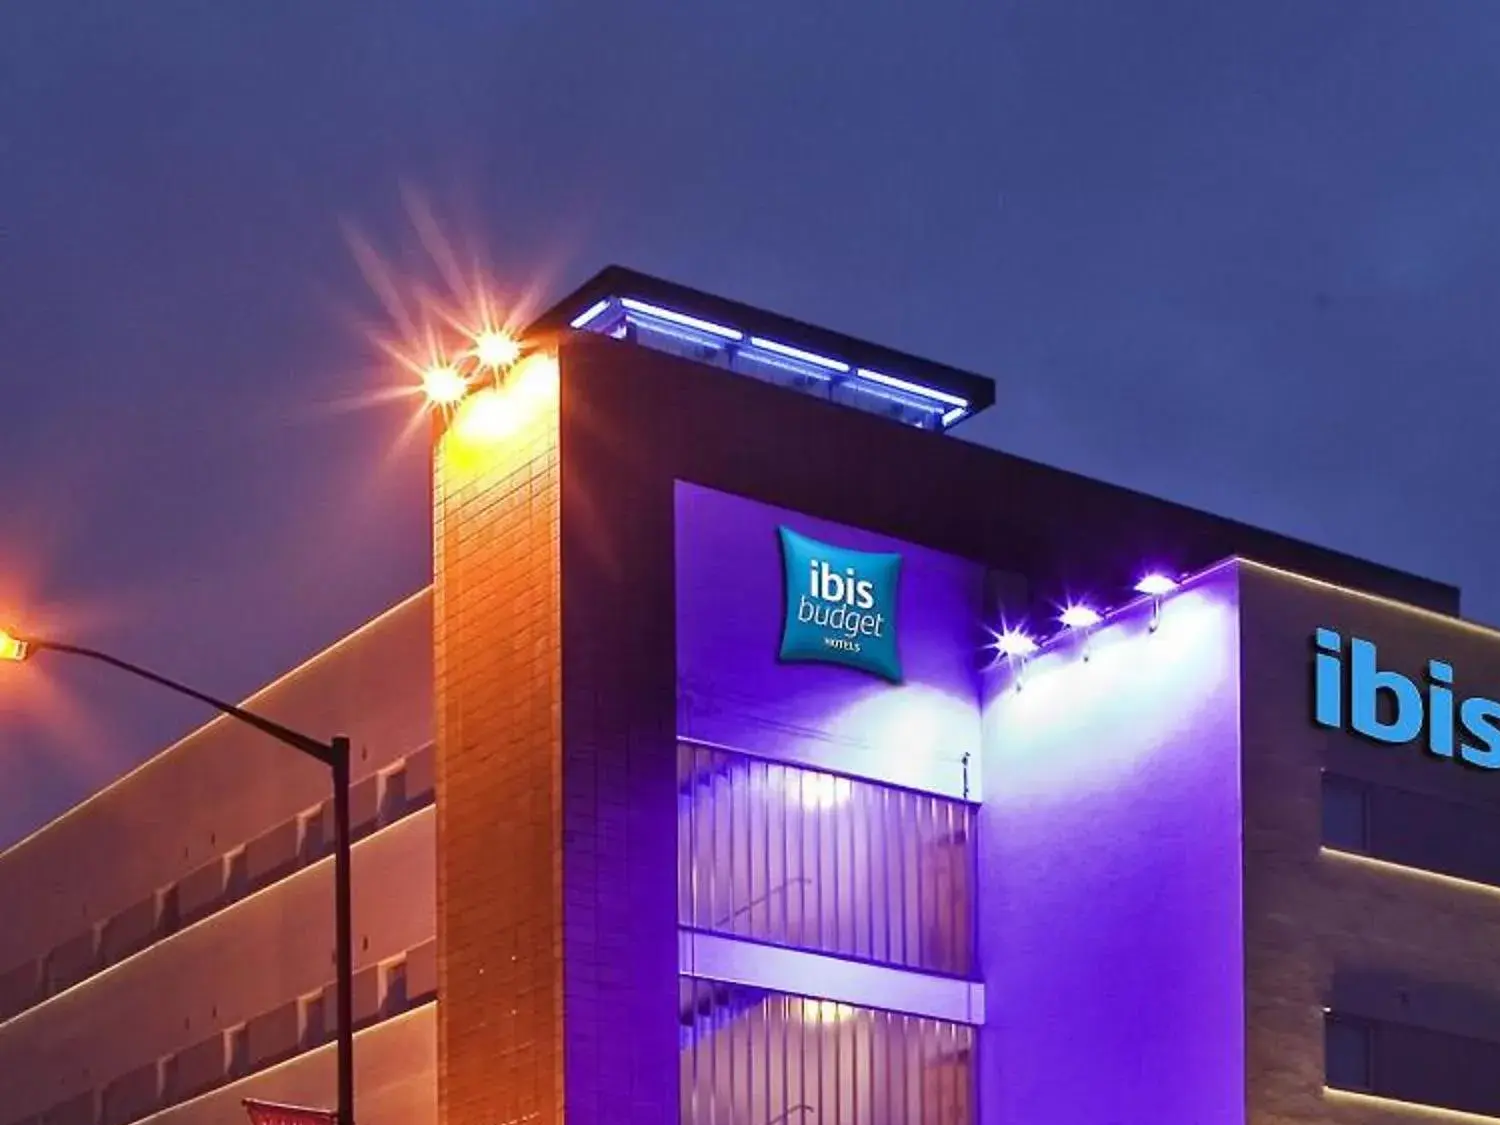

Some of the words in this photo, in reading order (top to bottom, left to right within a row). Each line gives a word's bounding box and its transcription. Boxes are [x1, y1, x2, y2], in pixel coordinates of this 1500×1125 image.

[810, 559, 874, 610] ibis
[797, 595, 885, 638] budget
[824, 636, 861, 653] HOTELS
